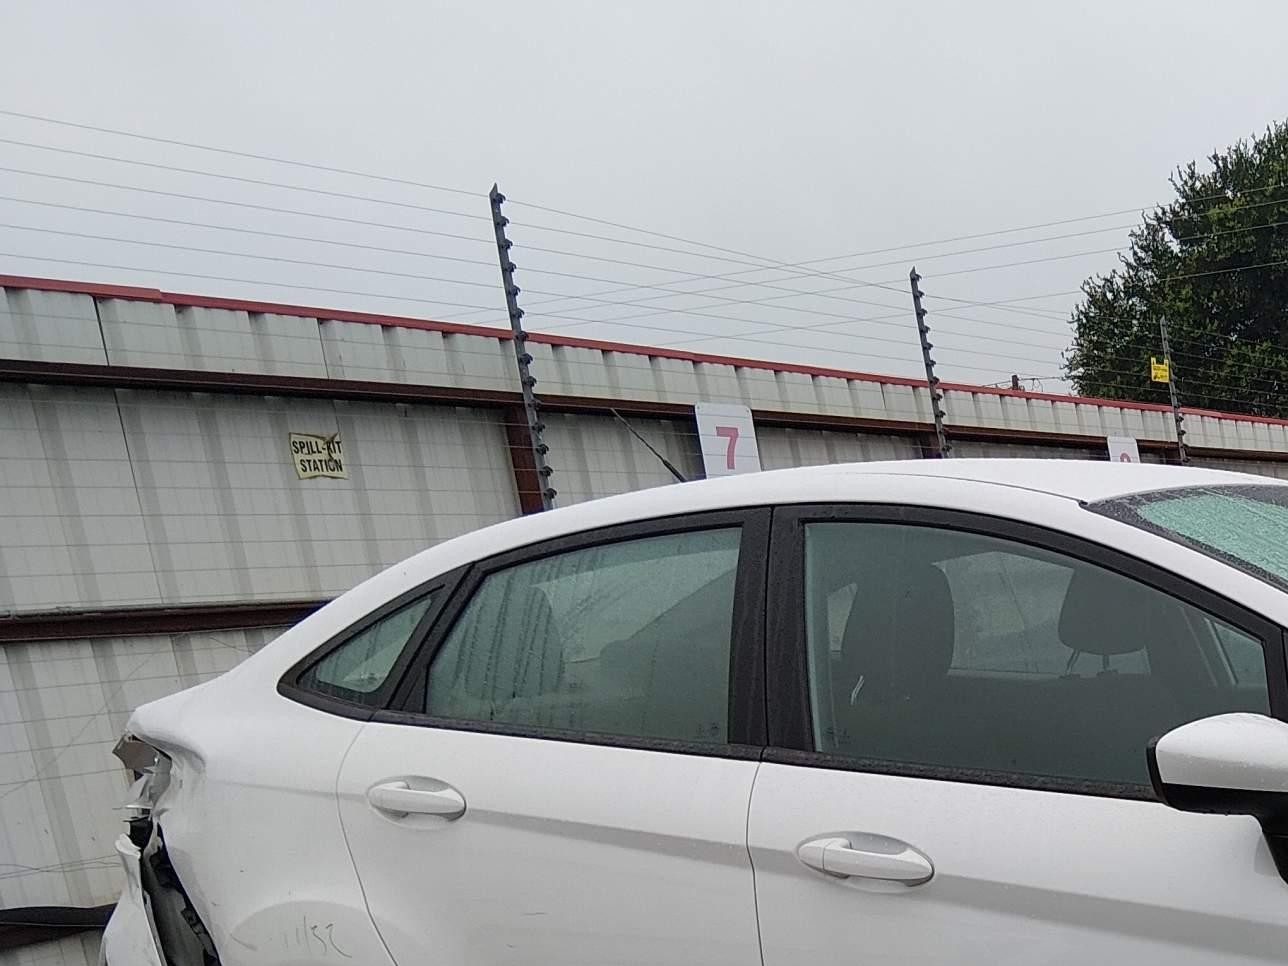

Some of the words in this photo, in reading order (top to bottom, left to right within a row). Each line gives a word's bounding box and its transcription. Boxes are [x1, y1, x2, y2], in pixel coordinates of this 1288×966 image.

[292, 440, 342, 455] SPILL-KIT
[715, 426, 739, 470] 7
[300, 459, 343, 473] STATION
